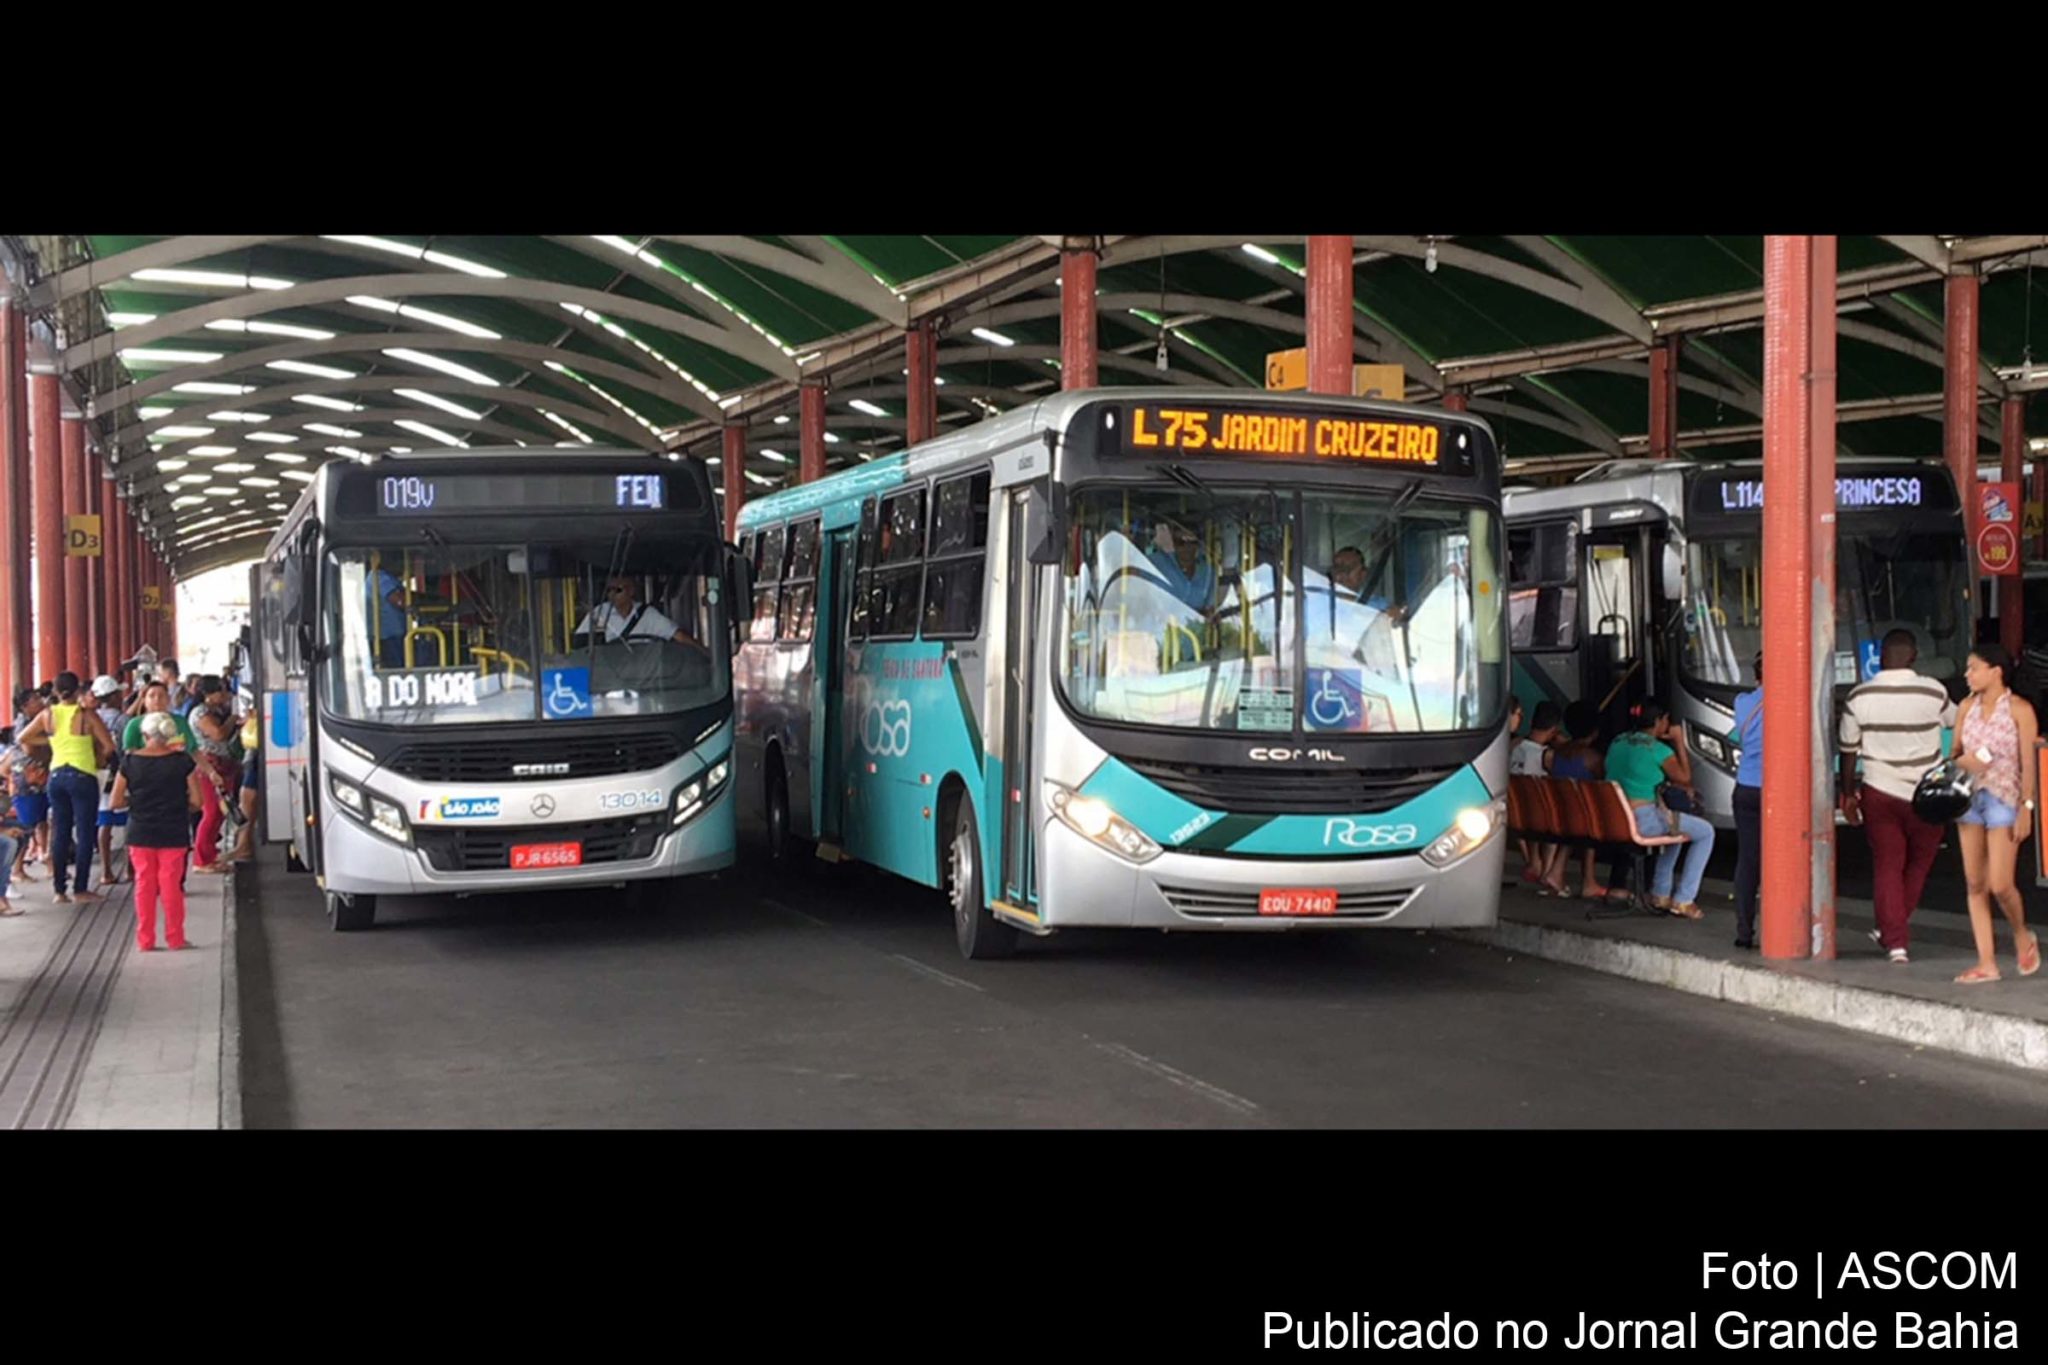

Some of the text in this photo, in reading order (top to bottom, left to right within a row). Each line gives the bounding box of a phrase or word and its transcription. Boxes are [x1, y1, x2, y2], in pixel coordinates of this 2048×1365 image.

[1133, 409, 1439, 460] L75 JARDIM CRUZEIRO
[1722, 481, 1764, 508] L114
[71, 529, 98, 548] D3
[388, 674, 419, 706] DO
[600, 790, 661, 809] 13014
[1323, 818, 1417, 847] Rosa
